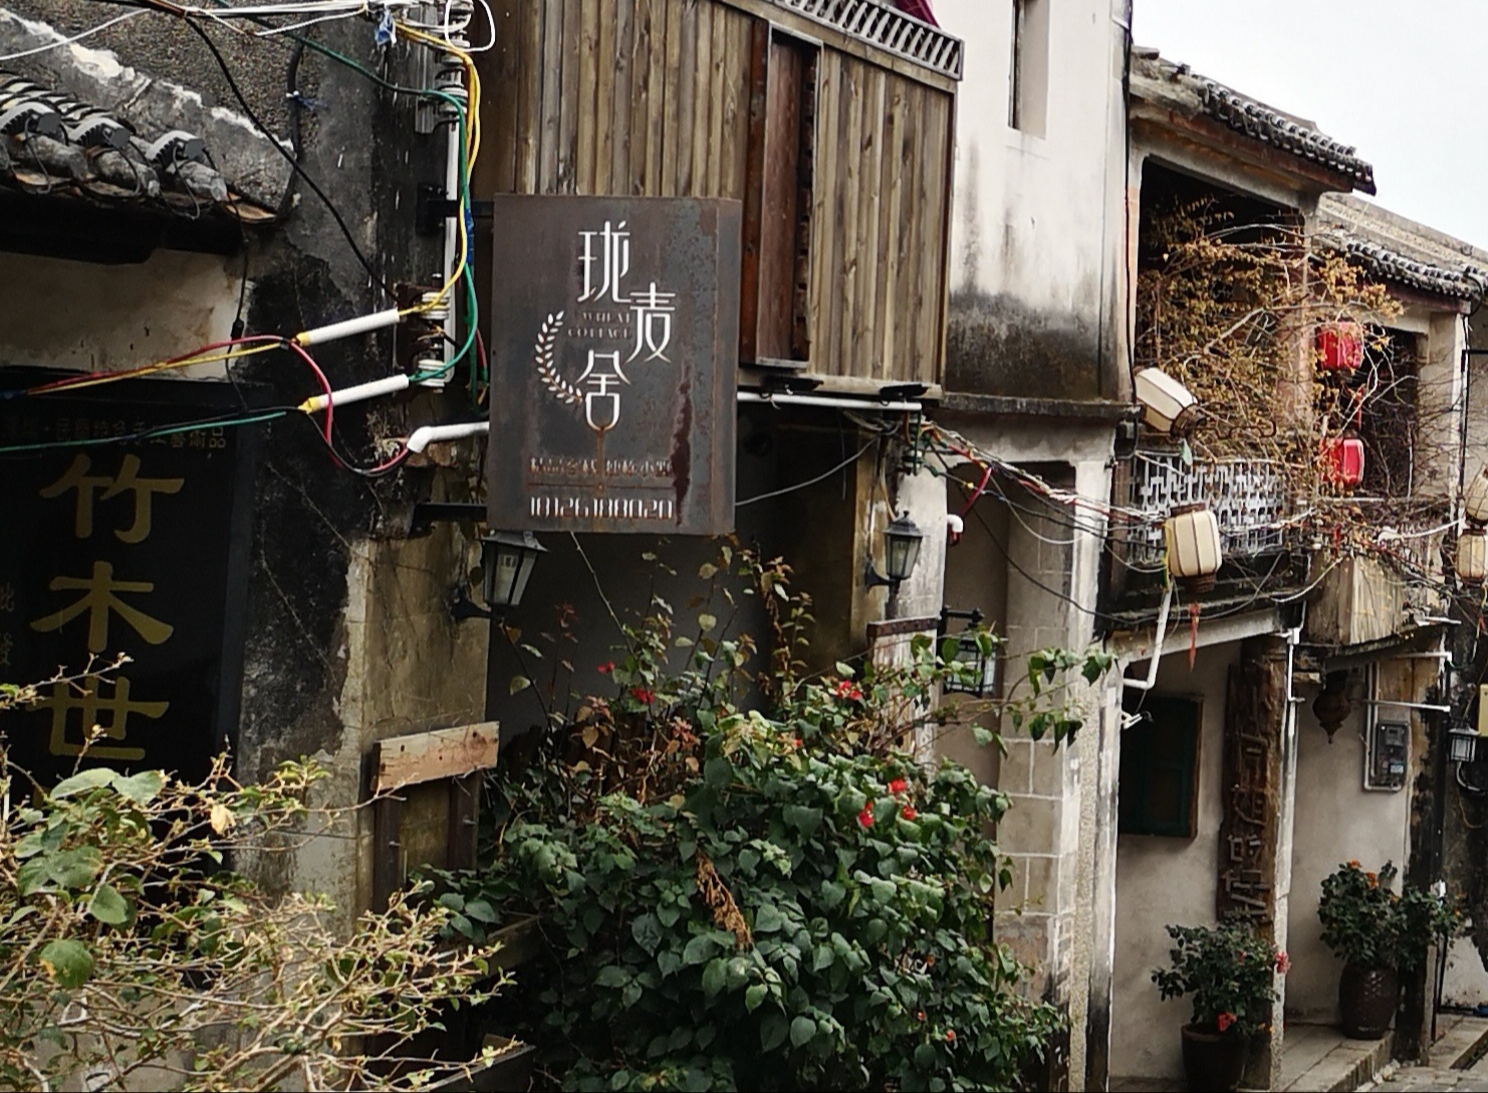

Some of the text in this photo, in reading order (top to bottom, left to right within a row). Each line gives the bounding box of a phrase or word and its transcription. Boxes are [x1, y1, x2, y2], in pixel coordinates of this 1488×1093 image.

[529, 495, 674, 521] 18126188020
[29, 452, 186, 807] 竹木世
